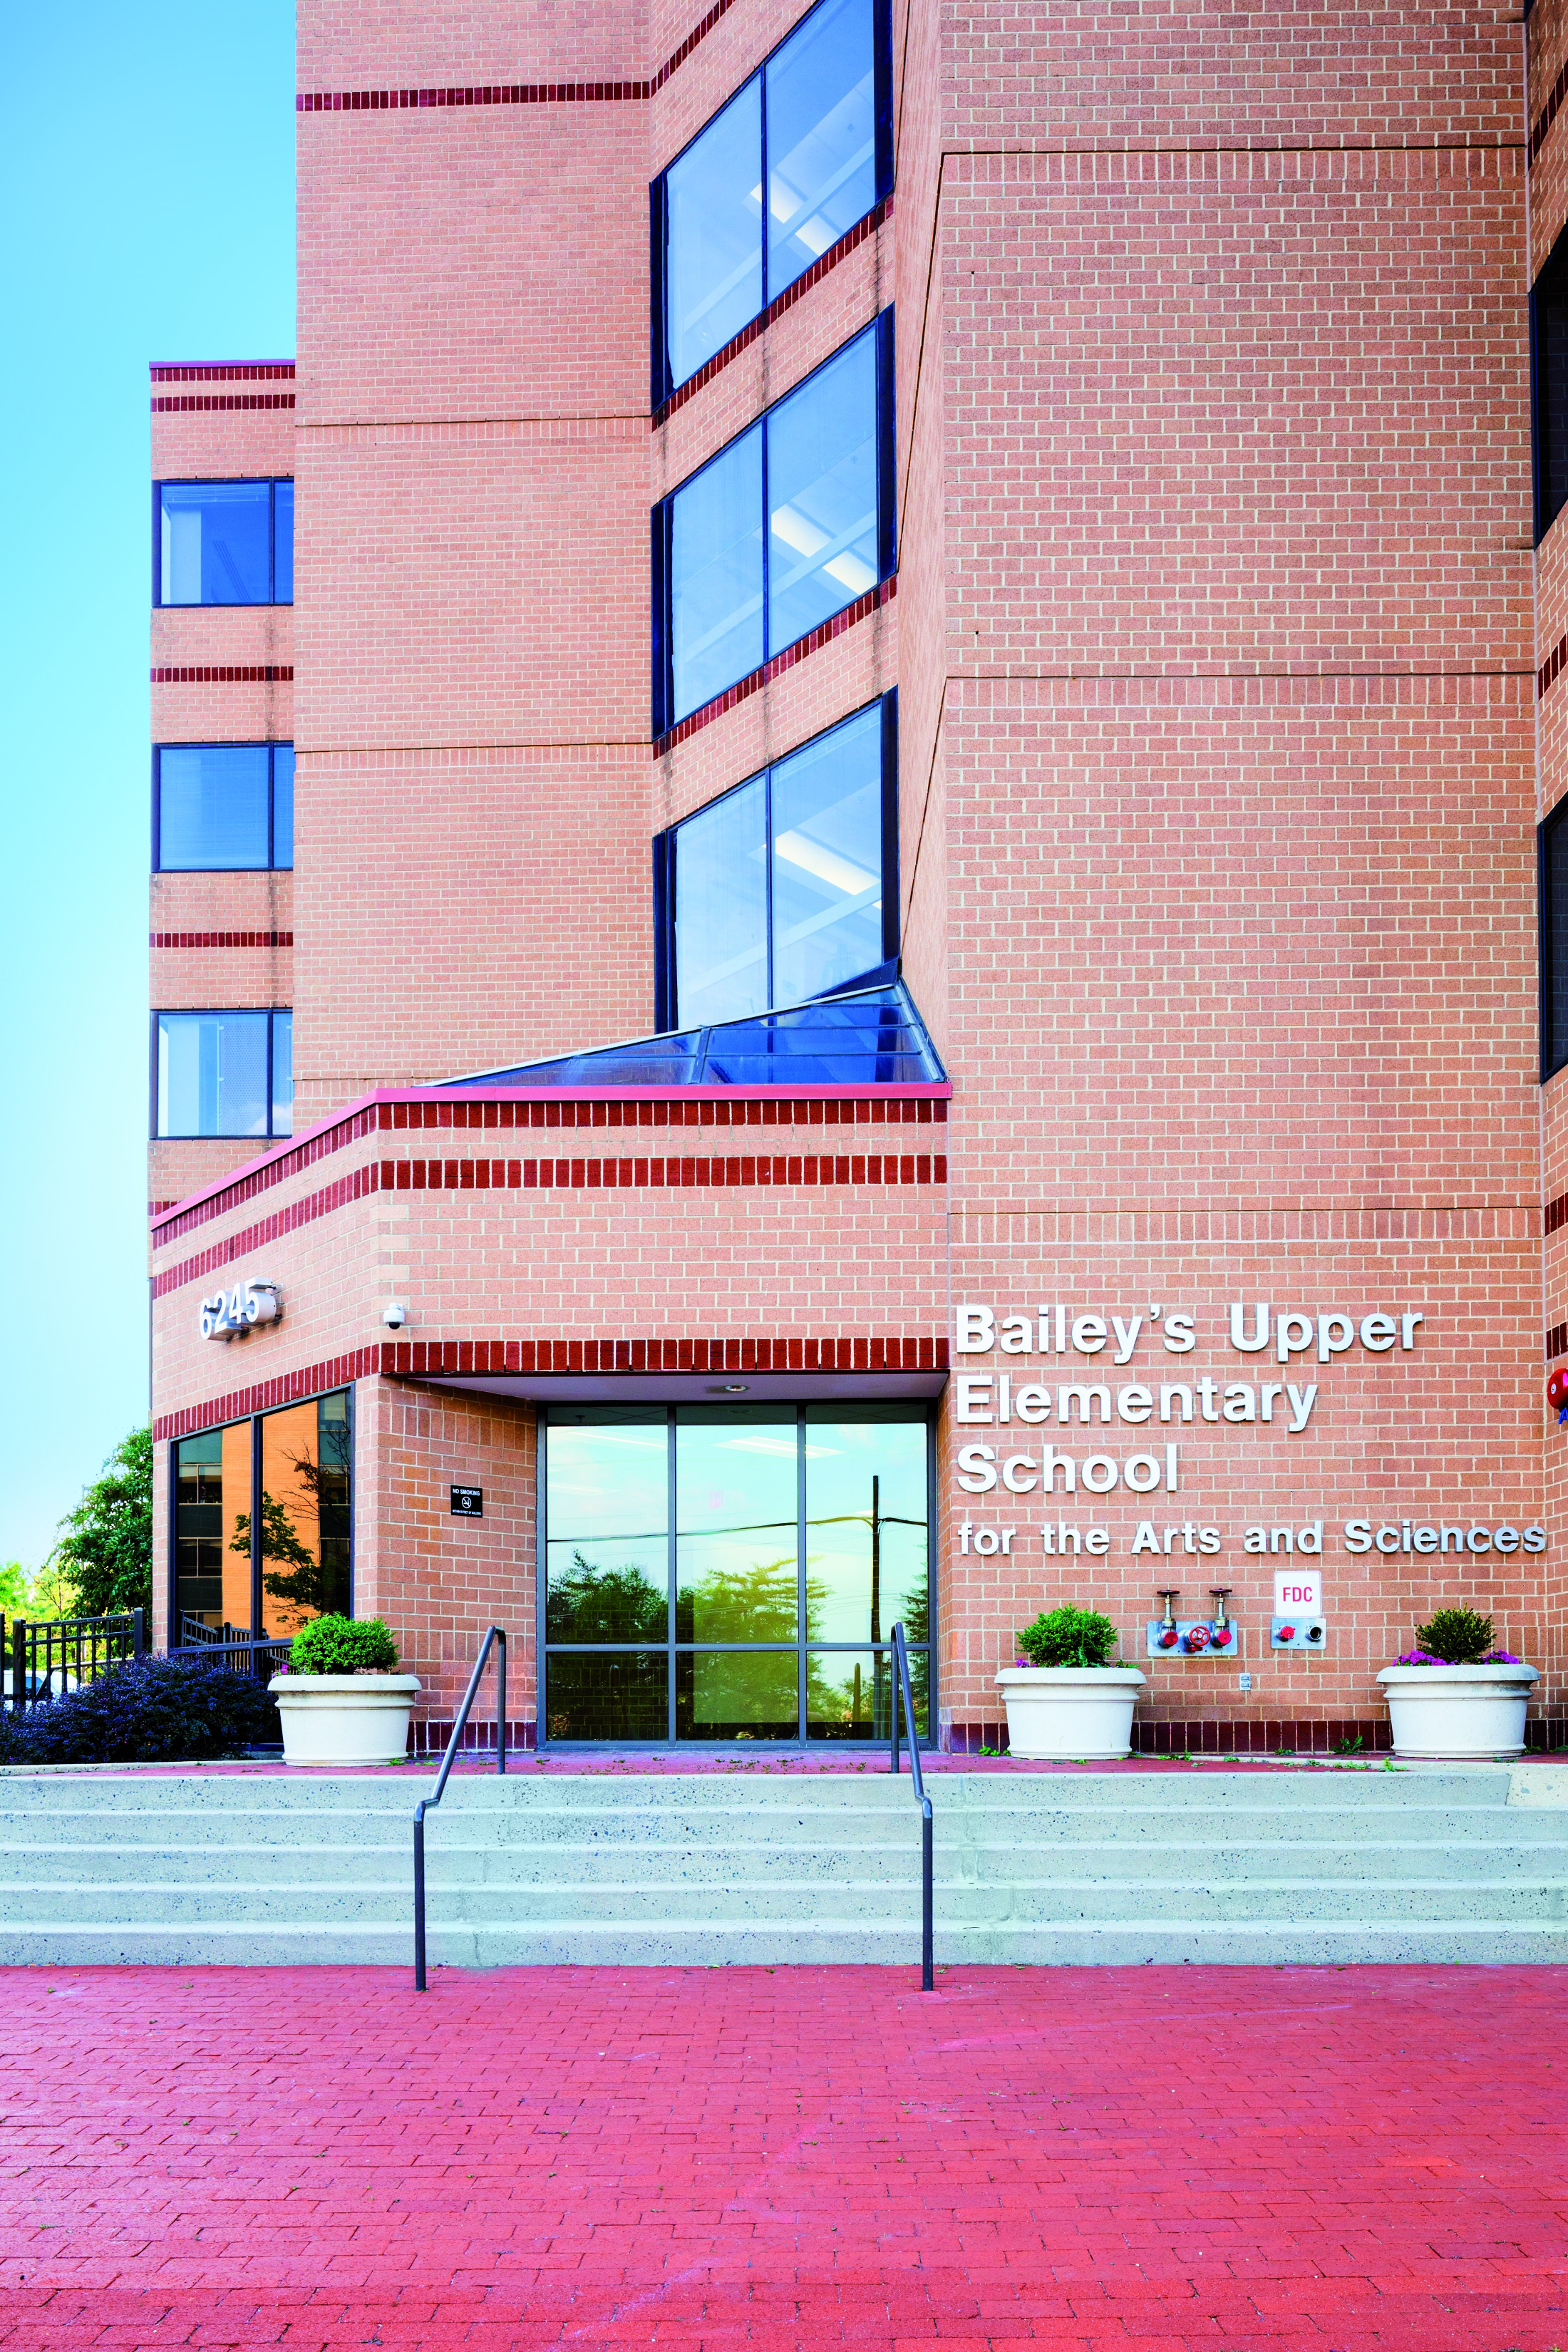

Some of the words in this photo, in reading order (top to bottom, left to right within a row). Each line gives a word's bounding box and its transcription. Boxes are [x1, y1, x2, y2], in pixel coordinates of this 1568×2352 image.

[200, 1277, 259, 1340] 6245
[956, 1304, 1197, 1364] Bailey’s
[1230, 1302, 1423, 1363] Upper
[957, 1375, 1318, 1433] Elementary
[957, 1443, 1177, 1493] School
[958, 1522, 1016, 1556] for
[1041, 1522, 1110, 1556] the
[1132, 1520, 1221, 1556] Arts
[1244, 1520, 1324, 1554] and
[1344, 1518, 1546, 1554] Sciences
[1283, 1587, 1313, 1602] FDC
